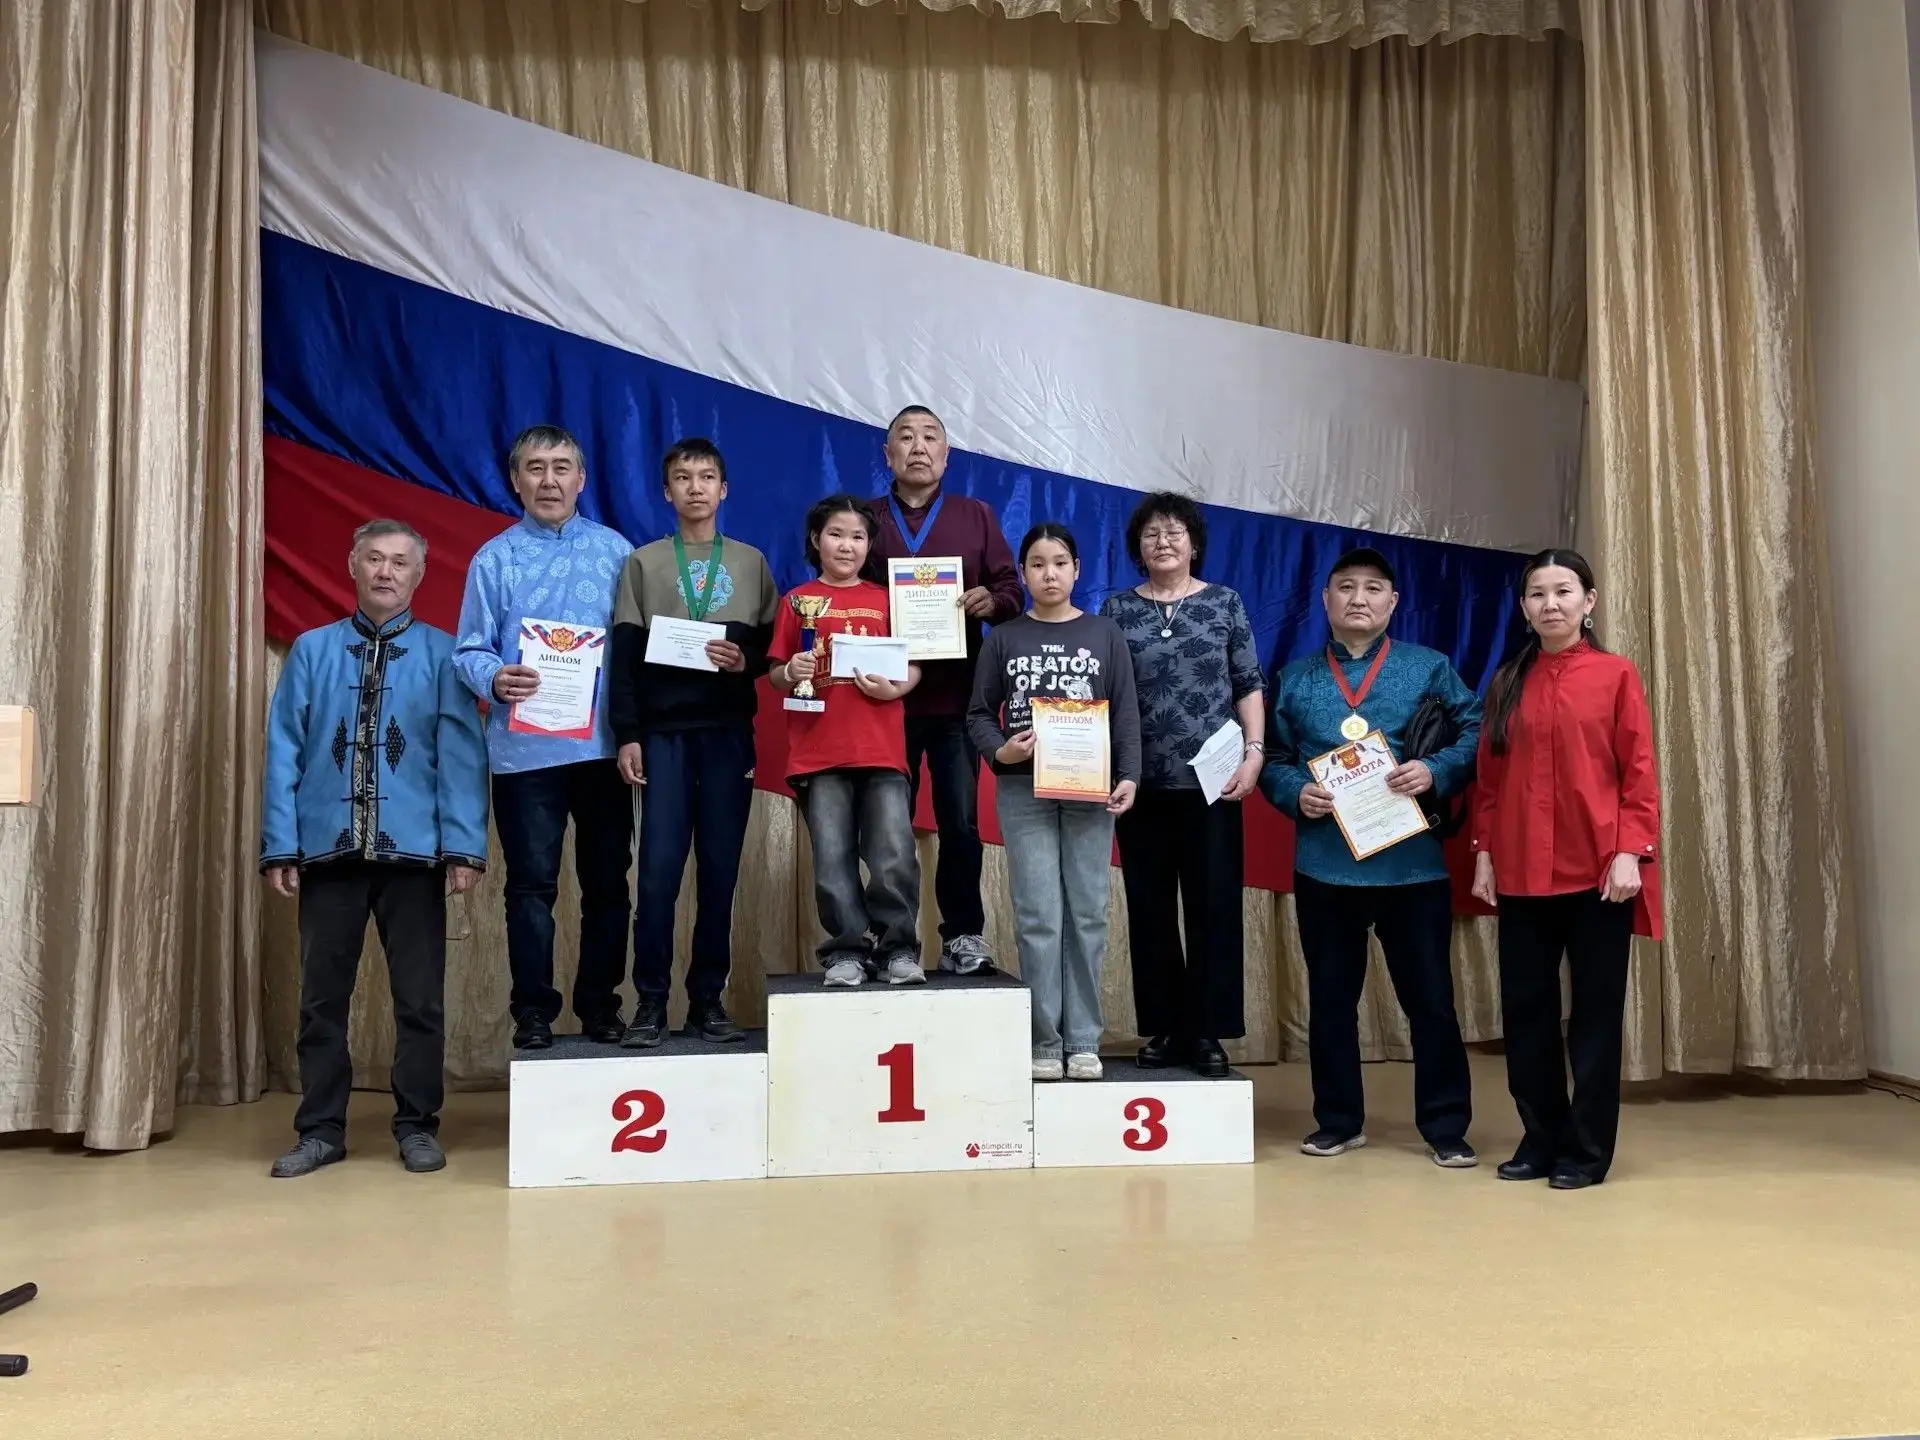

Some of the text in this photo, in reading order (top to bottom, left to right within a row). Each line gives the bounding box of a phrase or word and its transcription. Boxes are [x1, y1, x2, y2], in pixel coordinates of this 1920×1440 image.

[904, 589, 948, 599] ДИПЛОМ
[538, 653, 581, 665] ДИПЛОМ
[1006, 656, 1101, 676] CREATOR
[1015, 674, 1041, 691] OF
[1048, 715, 1093, 725] ДИПЛОМ
[1329, 758, 1386, 788] ГРАМОТА
[878, 1043, 925, 1123] 1
[611, 1089, 667, 1153] 2
[1123, 1097, 1168, 1151] 3
